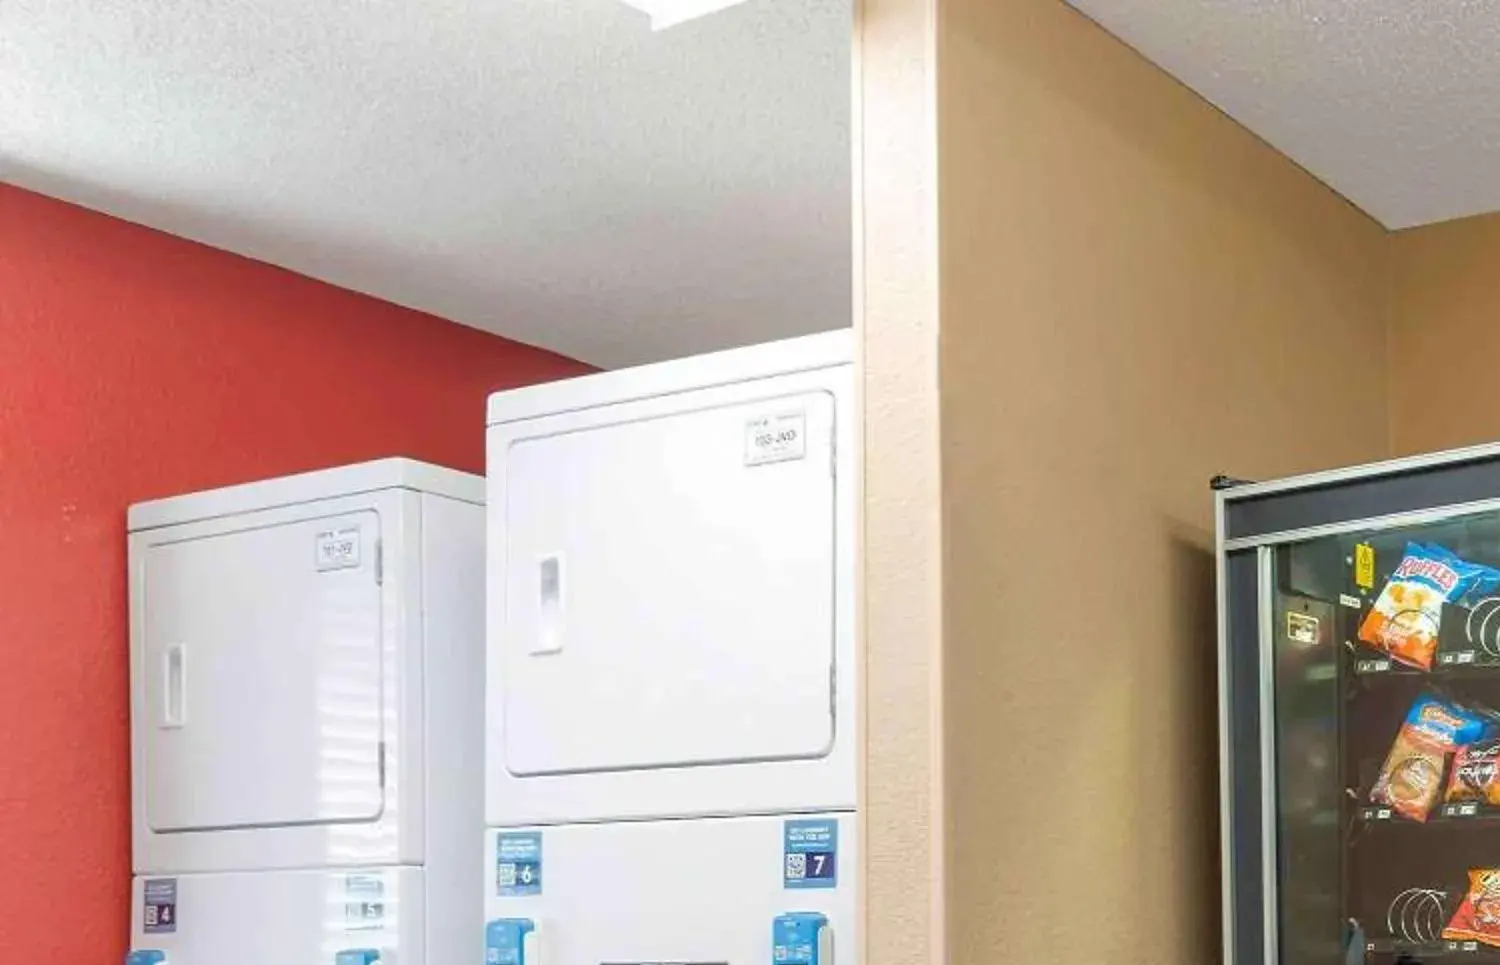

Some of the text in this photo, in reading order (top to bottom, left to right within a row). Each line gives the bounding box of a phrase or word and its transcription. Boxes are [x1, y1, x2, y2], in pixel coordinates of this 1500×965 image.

[523, 864, 531, 883] 6
[813, 855, 825, 876] 7
[159, 905, 171, 923] 4
